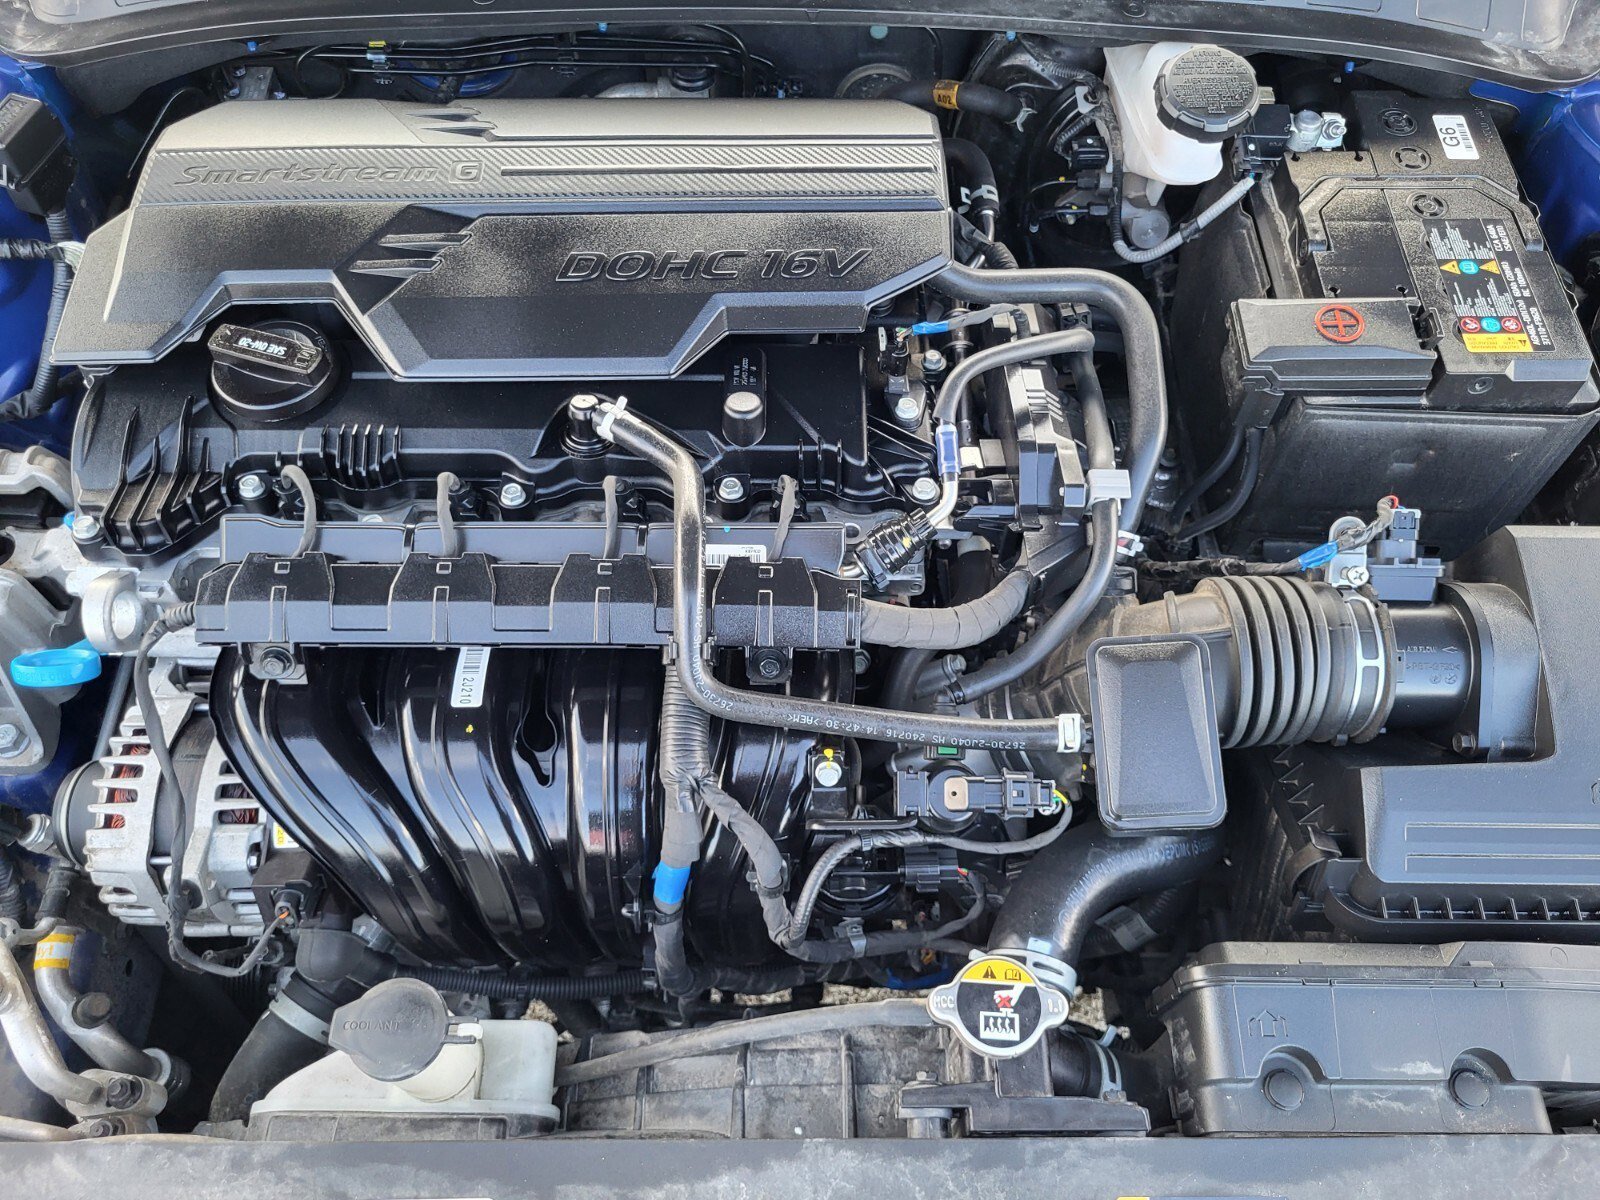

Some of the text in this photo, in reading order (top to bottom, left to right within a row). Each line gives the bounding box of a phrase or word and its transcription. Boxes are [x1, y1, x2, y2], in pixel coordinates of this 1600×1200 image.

[1439, 127, 1461, 147] G6
[174, 163, 480, 186] Smartstream G
[555, 248, 873, 282] DOHC 16V
[266, 344, 288, 356] SAE
[459, 677, 475, 704] 2J210
[886, 727, 926, 742] 240716
[932, 734, 946, 744] HS
[951, 736, 1026, 749] 26730-2J040
[1047, 998, 1062, 1013] 1.1
[343, 1020, 399, 1031] COOLANT
